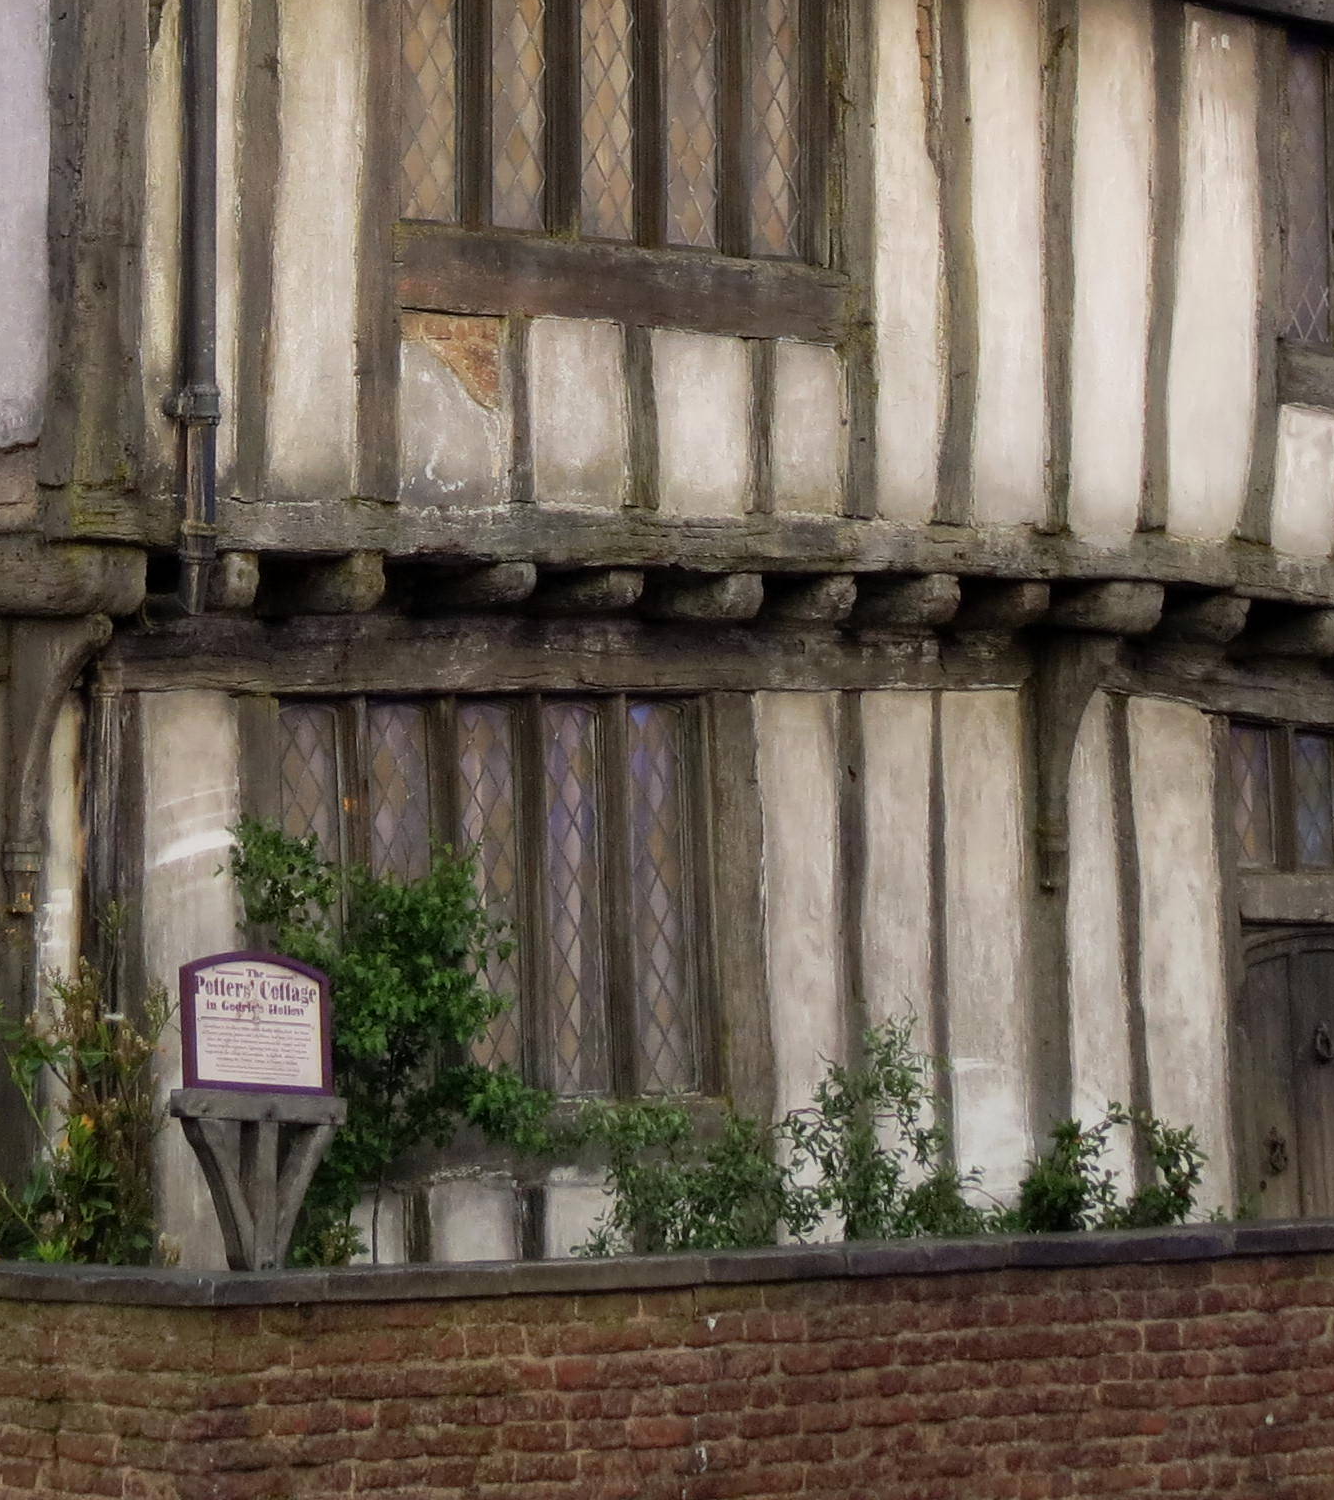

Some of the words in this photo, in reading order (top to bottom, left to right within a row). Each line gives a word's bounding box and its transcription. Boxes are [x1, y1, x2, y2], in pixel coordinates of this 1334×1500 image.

[245, 968, 265, 978] The
[195, 975, 255, 999] Potters'
[259, 980, 317, 1007] Cottage
[206, 999, 217, 1010] in
[221, 1000, 264, 1015] Godric's
[268, 1003, 304, 1016] Hollow
